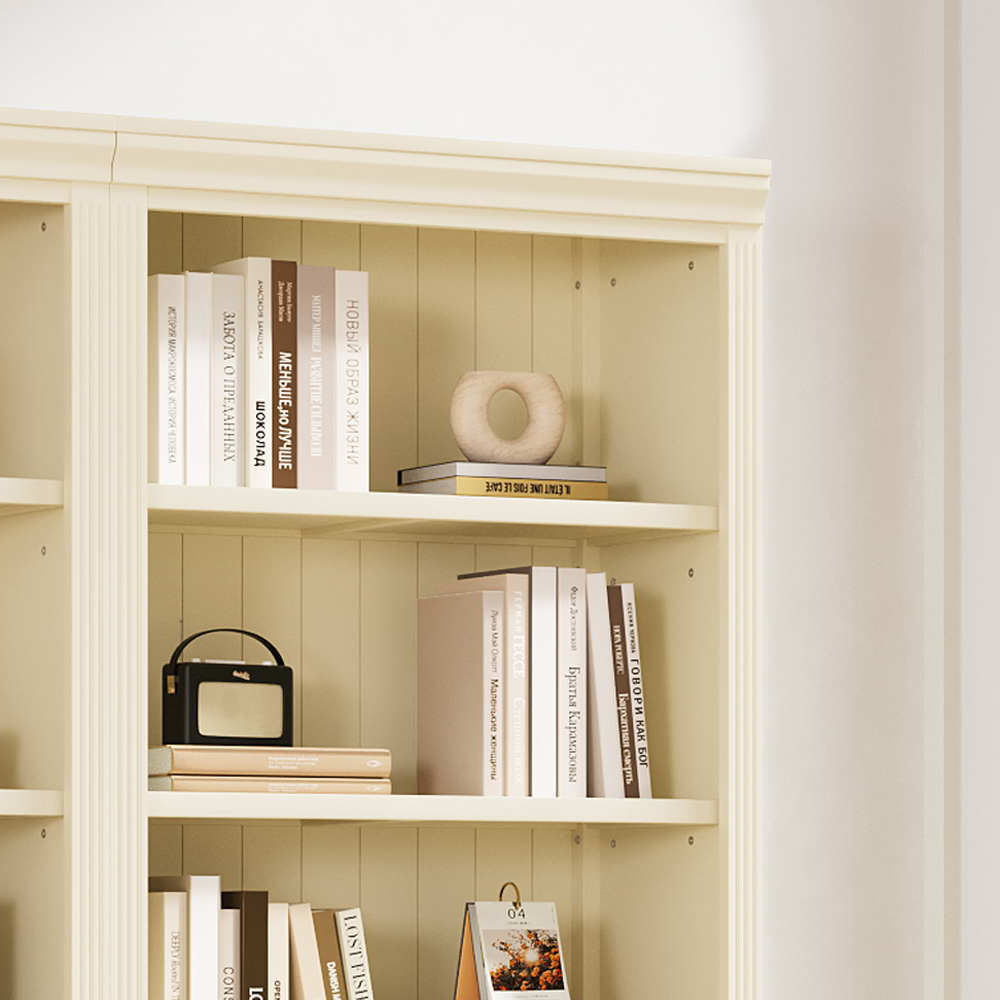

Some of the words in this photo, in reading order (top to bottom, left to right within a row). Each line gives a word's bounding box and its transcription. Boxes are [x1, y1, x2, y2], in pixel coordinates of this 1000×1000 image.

[223, 311, 236, 360] ЗАБОТА
[346, 300, 362, 352] НОВЫЙ
[223, 366, 236, 376] О
[346, 359, 360, 406] ОБРАЗ
[222, 379, 236, 462] ПРЕДАННЫХ
[254, 401, 266, 466] ШОКОЛАД
[346, 410, 360, 465] ЖИЗНИ
[279, 426, 292, 470] ЛУЧШЕ
[514, 591, 522, 632] ГЕРМАН
[513, 635, 525, 680] ГЕССЕ
[490, 679, 499, 732] Маленькие
[565, 667, 580, 708] Братья
[630, 658, 644, 714] ГОВОРИ
[513, 698, 526, 754] Степной
[565, 711, 580, 782] Карамазовы
[636, 720, 646, 742] КАК
[490, 735, 498, 780] женщины
[638, 746, 648, 768] БОГ
[343, 914, 364, 958] LOST
[508, 908, 526, 920] 04
[326, 962, 340, 992] DANISH
